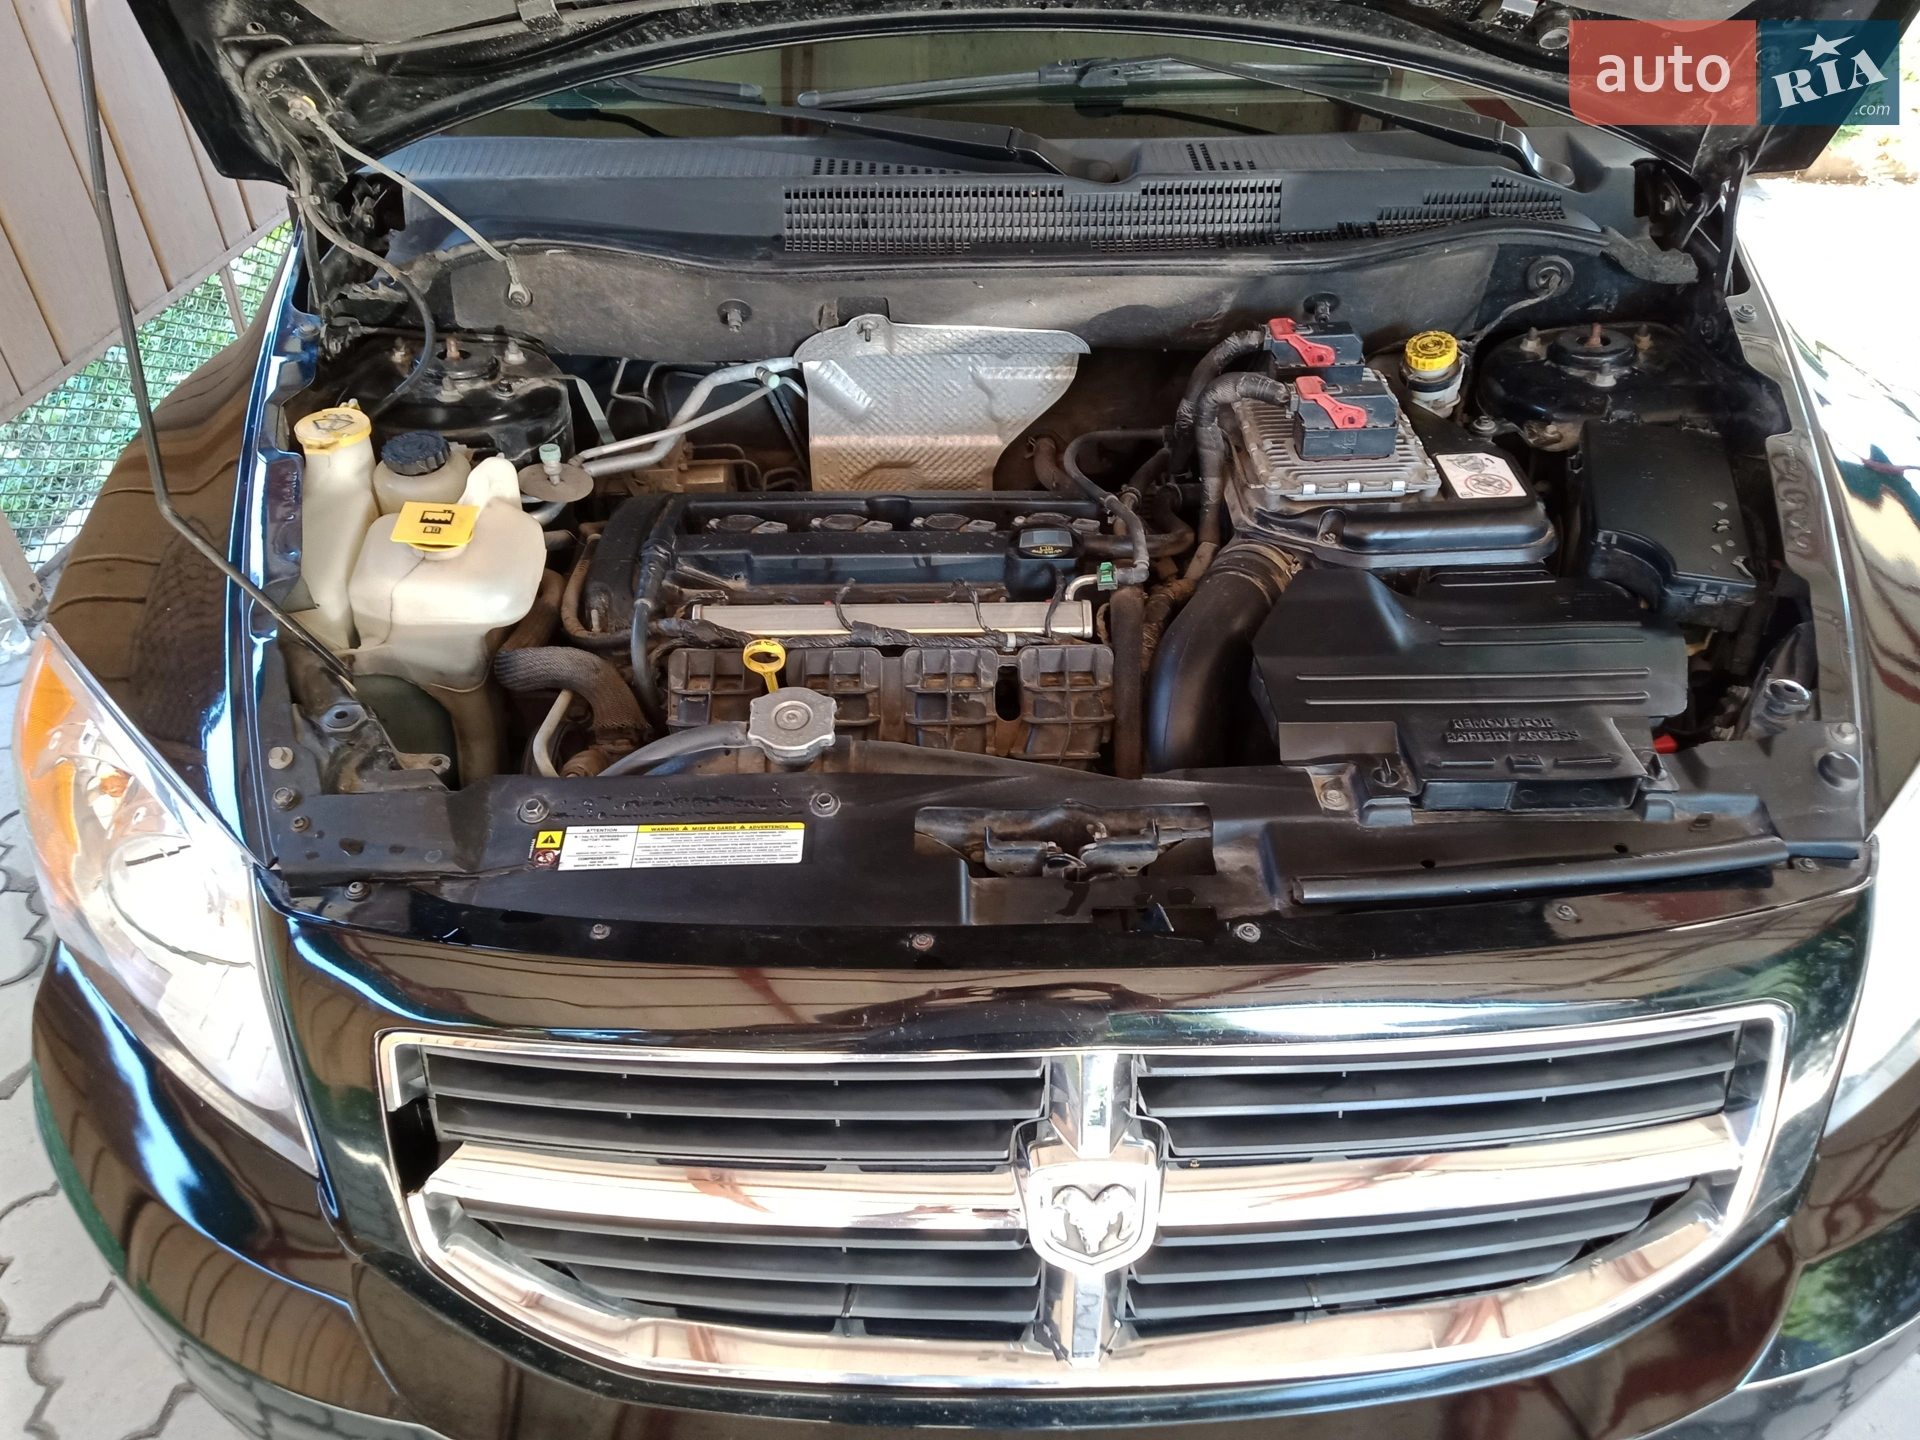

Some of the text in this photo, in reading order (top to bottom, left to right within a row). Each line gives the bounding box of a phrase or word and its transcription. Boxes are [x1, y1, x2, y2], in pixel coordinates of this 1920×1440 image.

[1451, 718, 1555, 729] REMOVE FOR
[1446, 730, 1581, 743] BATTERY ACCESS
